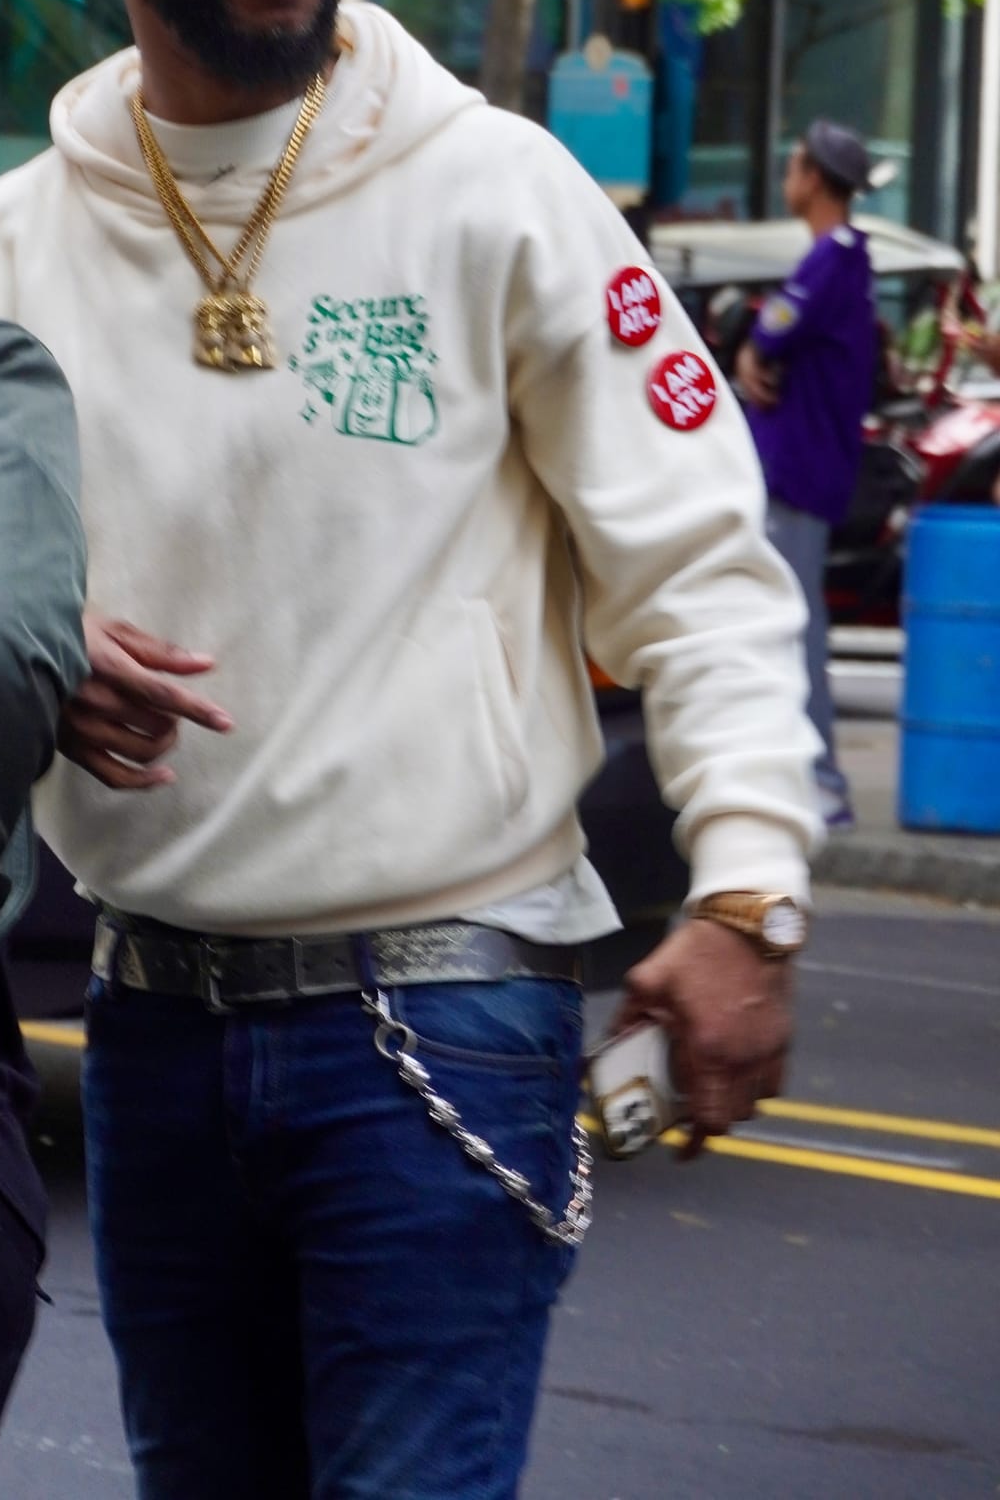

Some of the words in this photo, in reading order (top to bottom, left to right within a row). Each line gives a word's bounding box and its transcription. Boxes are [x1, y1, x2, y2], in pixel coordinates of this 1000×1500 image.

[607, 288, 624, 313] I
[620, 274, 657, 308] AM
[651, 382, 673, 404] I
[664, 355, 705, 395] AM
